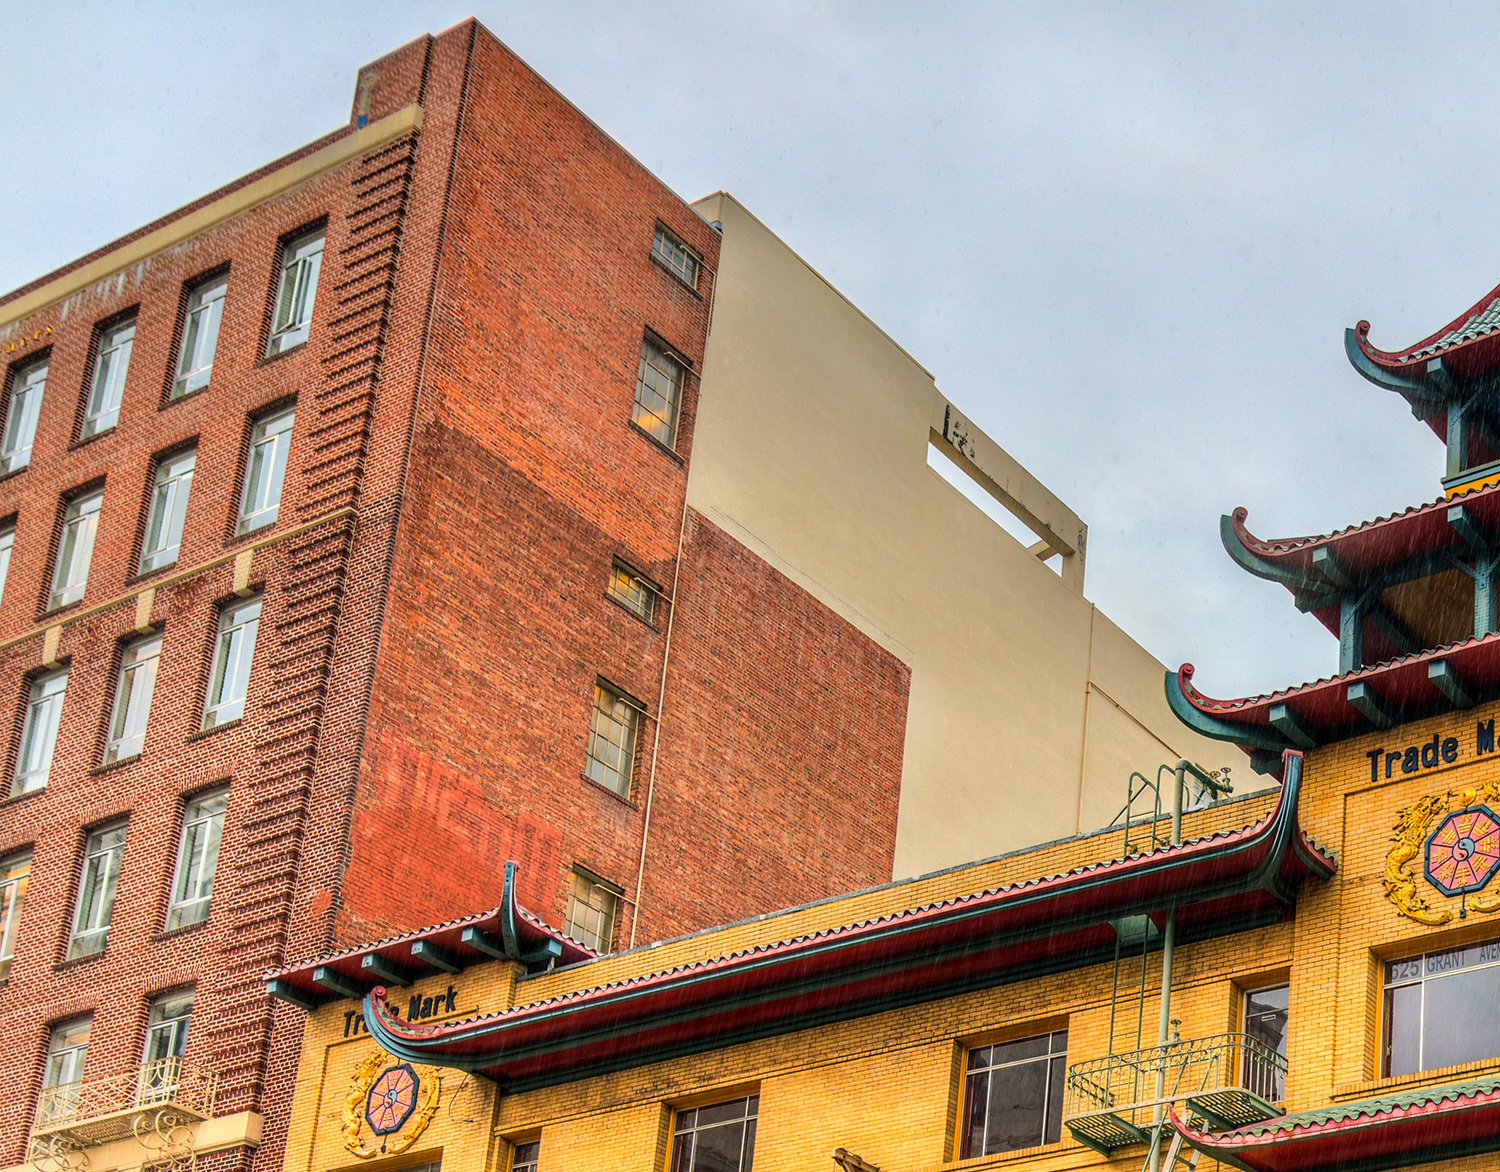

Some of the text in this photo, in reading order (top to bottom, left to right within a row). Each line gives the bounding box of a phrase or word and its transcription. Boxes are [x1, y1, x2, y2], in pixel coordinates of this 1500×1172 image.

[1367, 734, 1458, 782] Trade
[1392, 961, 1419, 980] 625
[1427, 949, 1467, 973] GRANT
[344, 986, 458, 1037] Tre Mark
